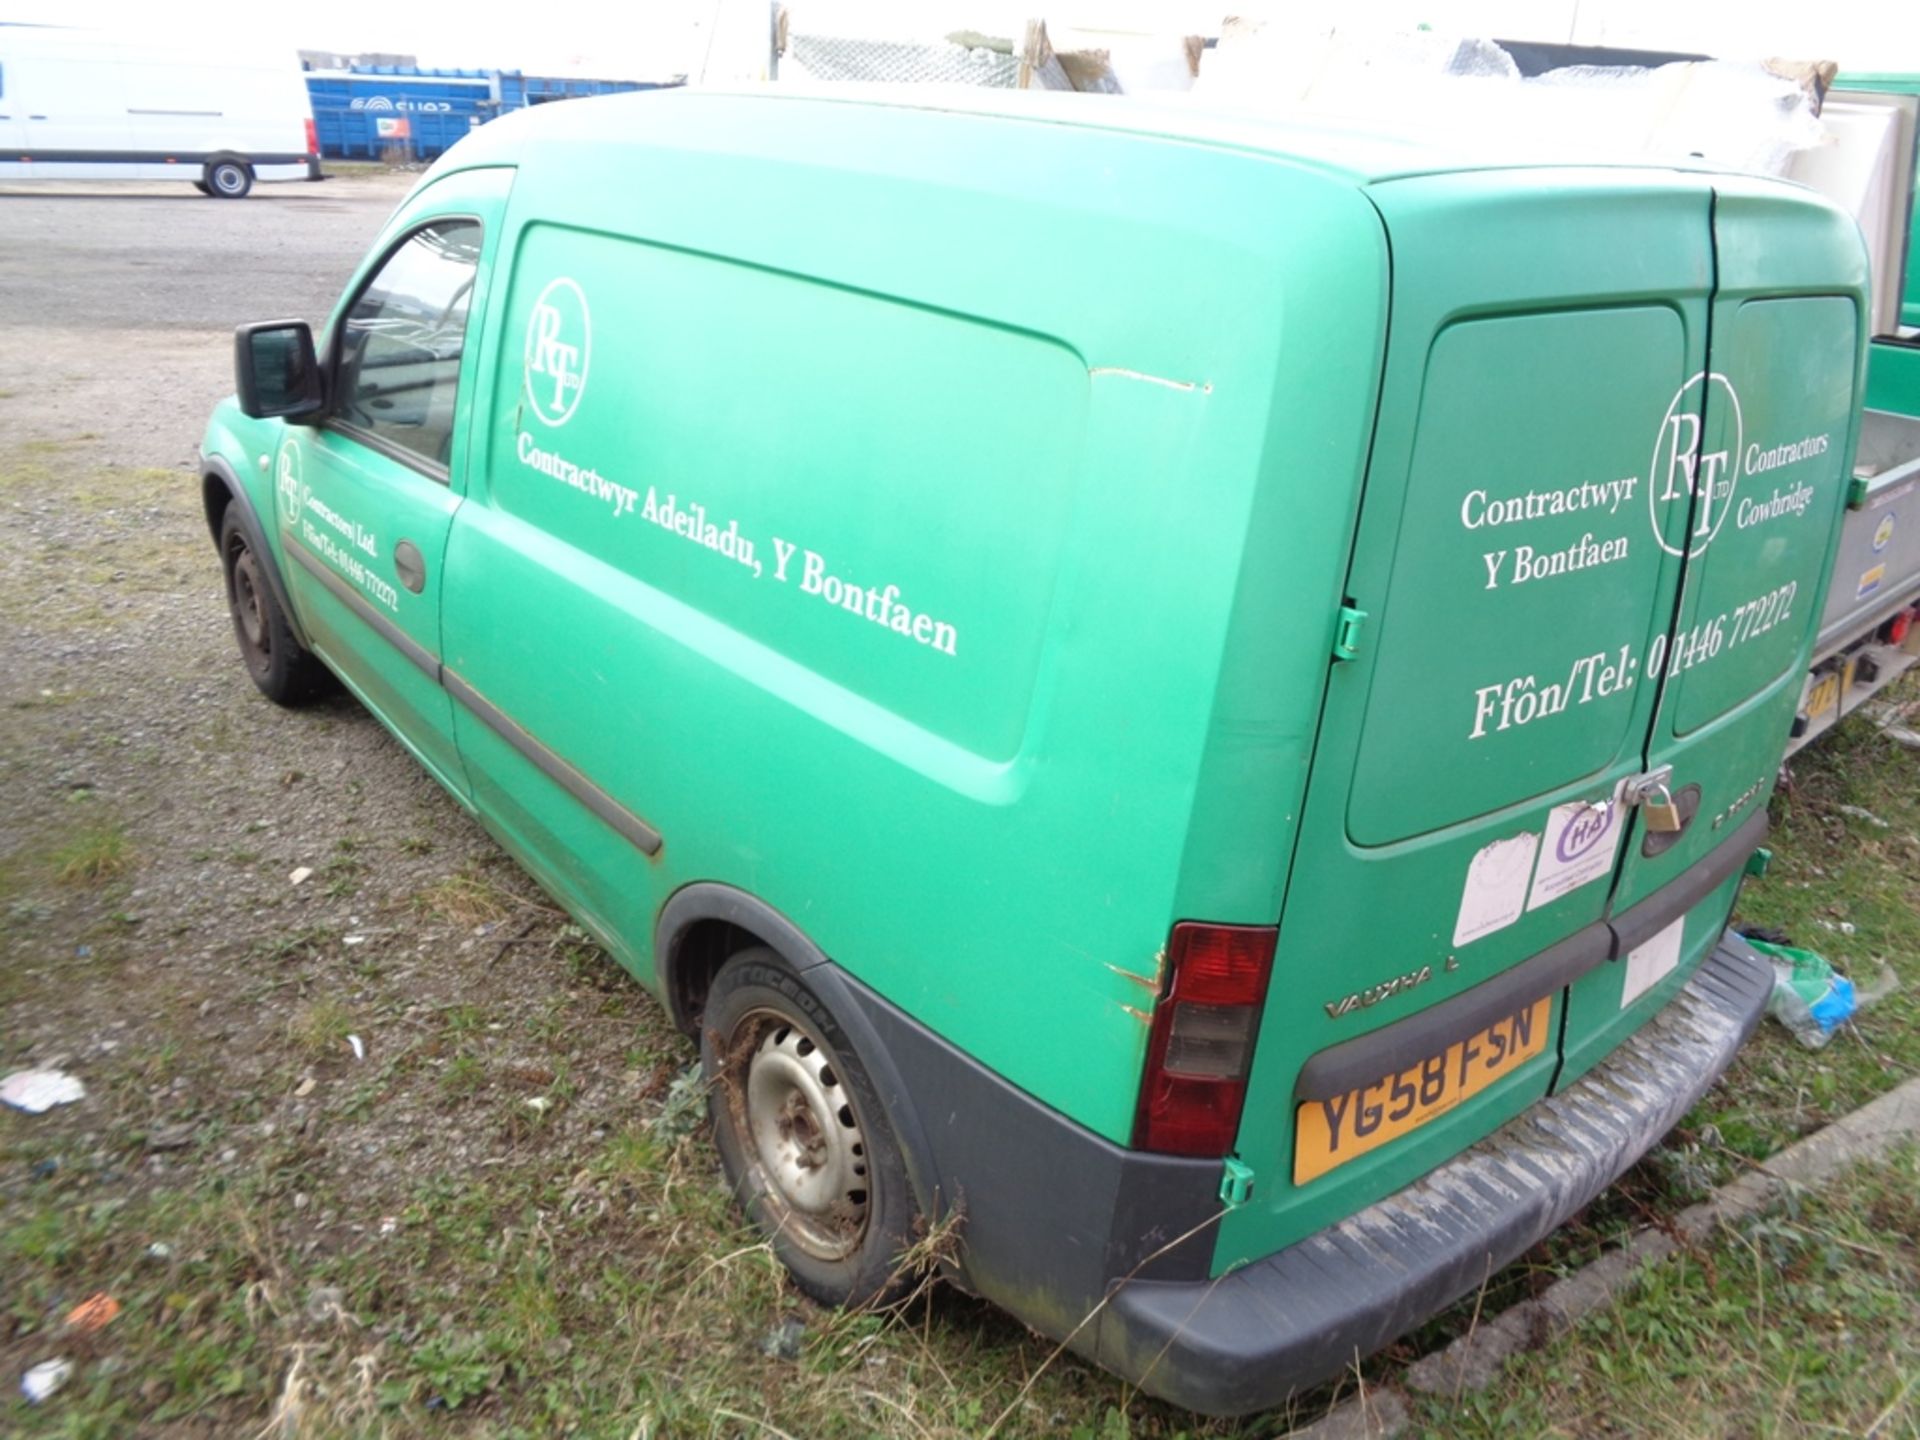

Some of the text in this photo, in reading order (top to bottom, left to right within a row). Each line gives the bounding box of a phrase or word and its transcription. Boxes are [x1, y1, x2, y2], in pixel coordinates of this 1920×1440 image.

[1745, 433, 1829, 476] Contractors
[1461, 476, 1638, 530] Contractwyr
[1736, 481, 1813, 531] Cowbridge
[517, 431, 958, 656] Contractwyr Adeiladu, Y Bontfaen
[1484, 533, 1628, 590] Y Bontfaen
[1469, 580, 1797, 740] Ffôn/Tel: 01446 772272
[1322, 1003, 1533, 1153] YG58 FSN
